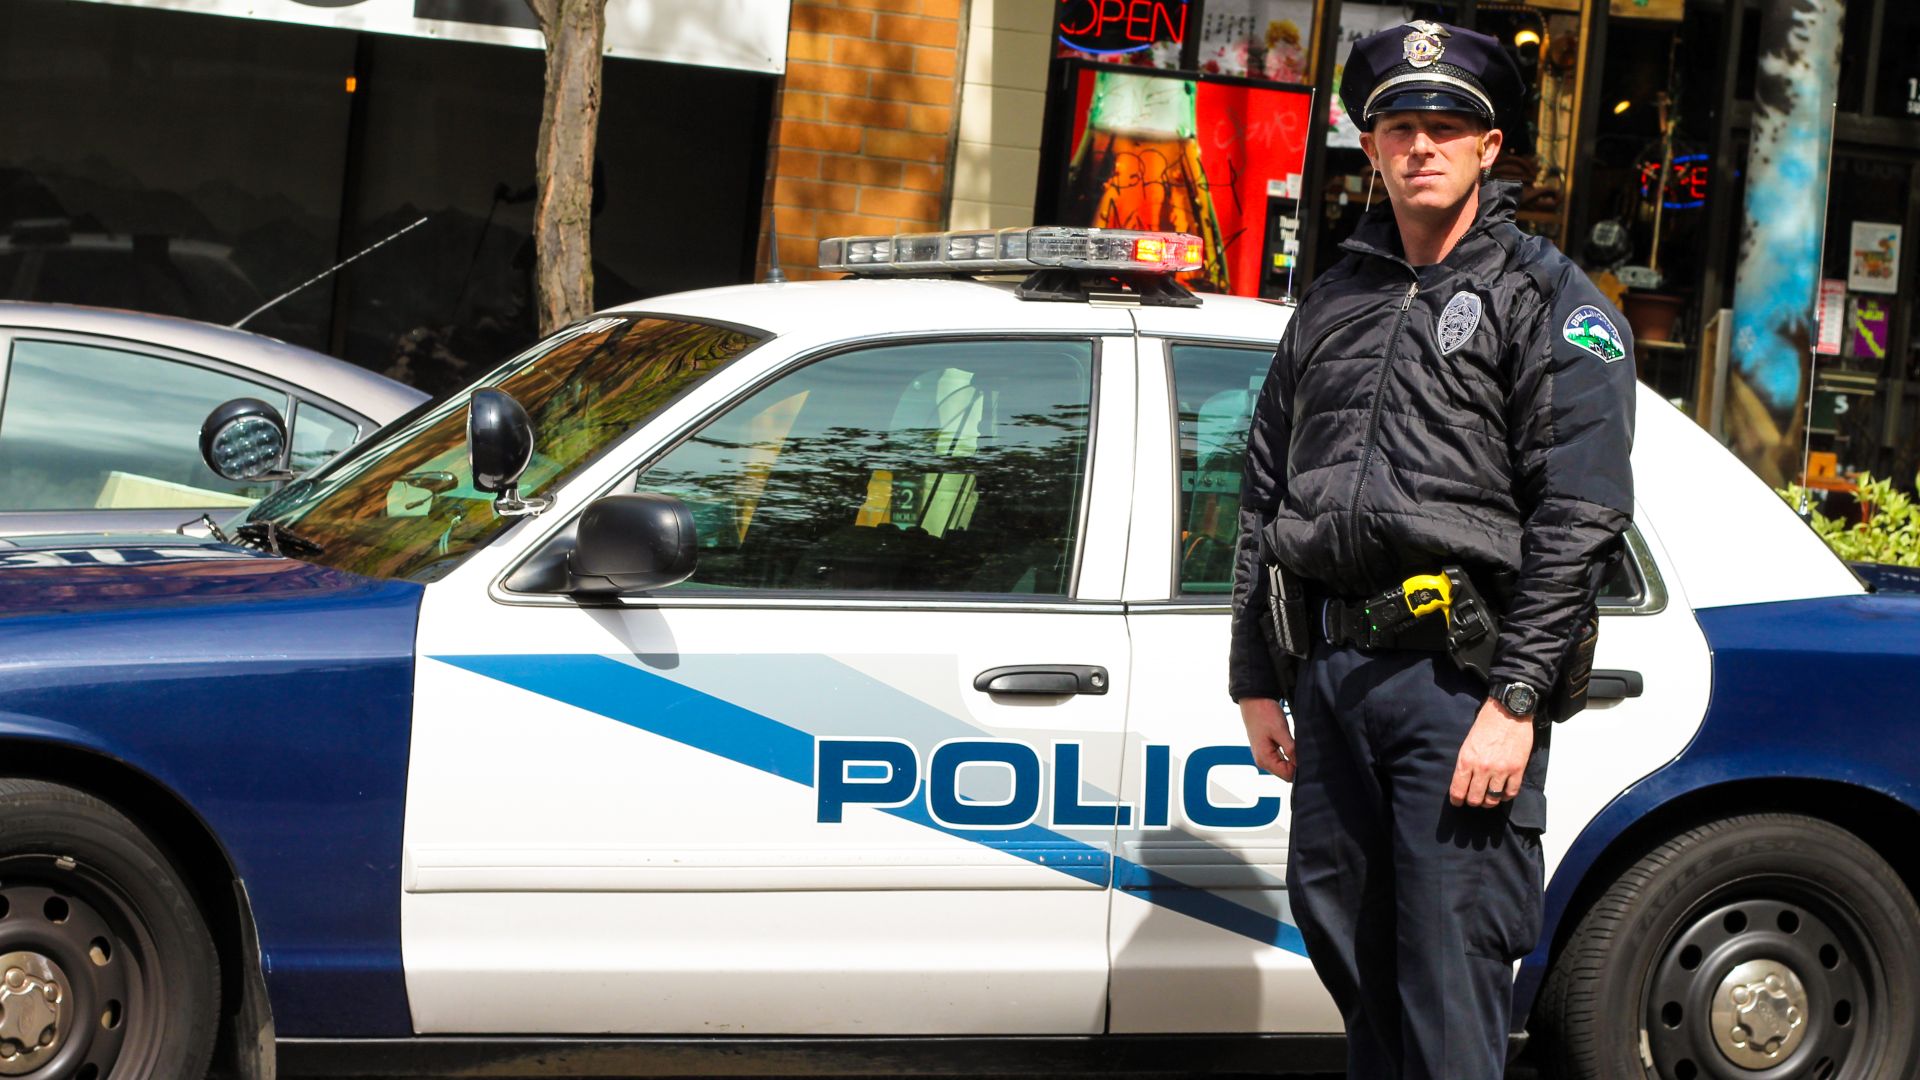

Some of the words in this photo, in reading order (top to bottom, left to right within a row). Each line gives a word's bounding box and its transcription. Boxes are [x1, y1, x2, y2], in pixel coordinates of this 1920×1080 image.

[1059, 0, 1187, 43] OPEN
[901, 489, 914, 509] 2
[815, 738, 1282, 829] POLIC
